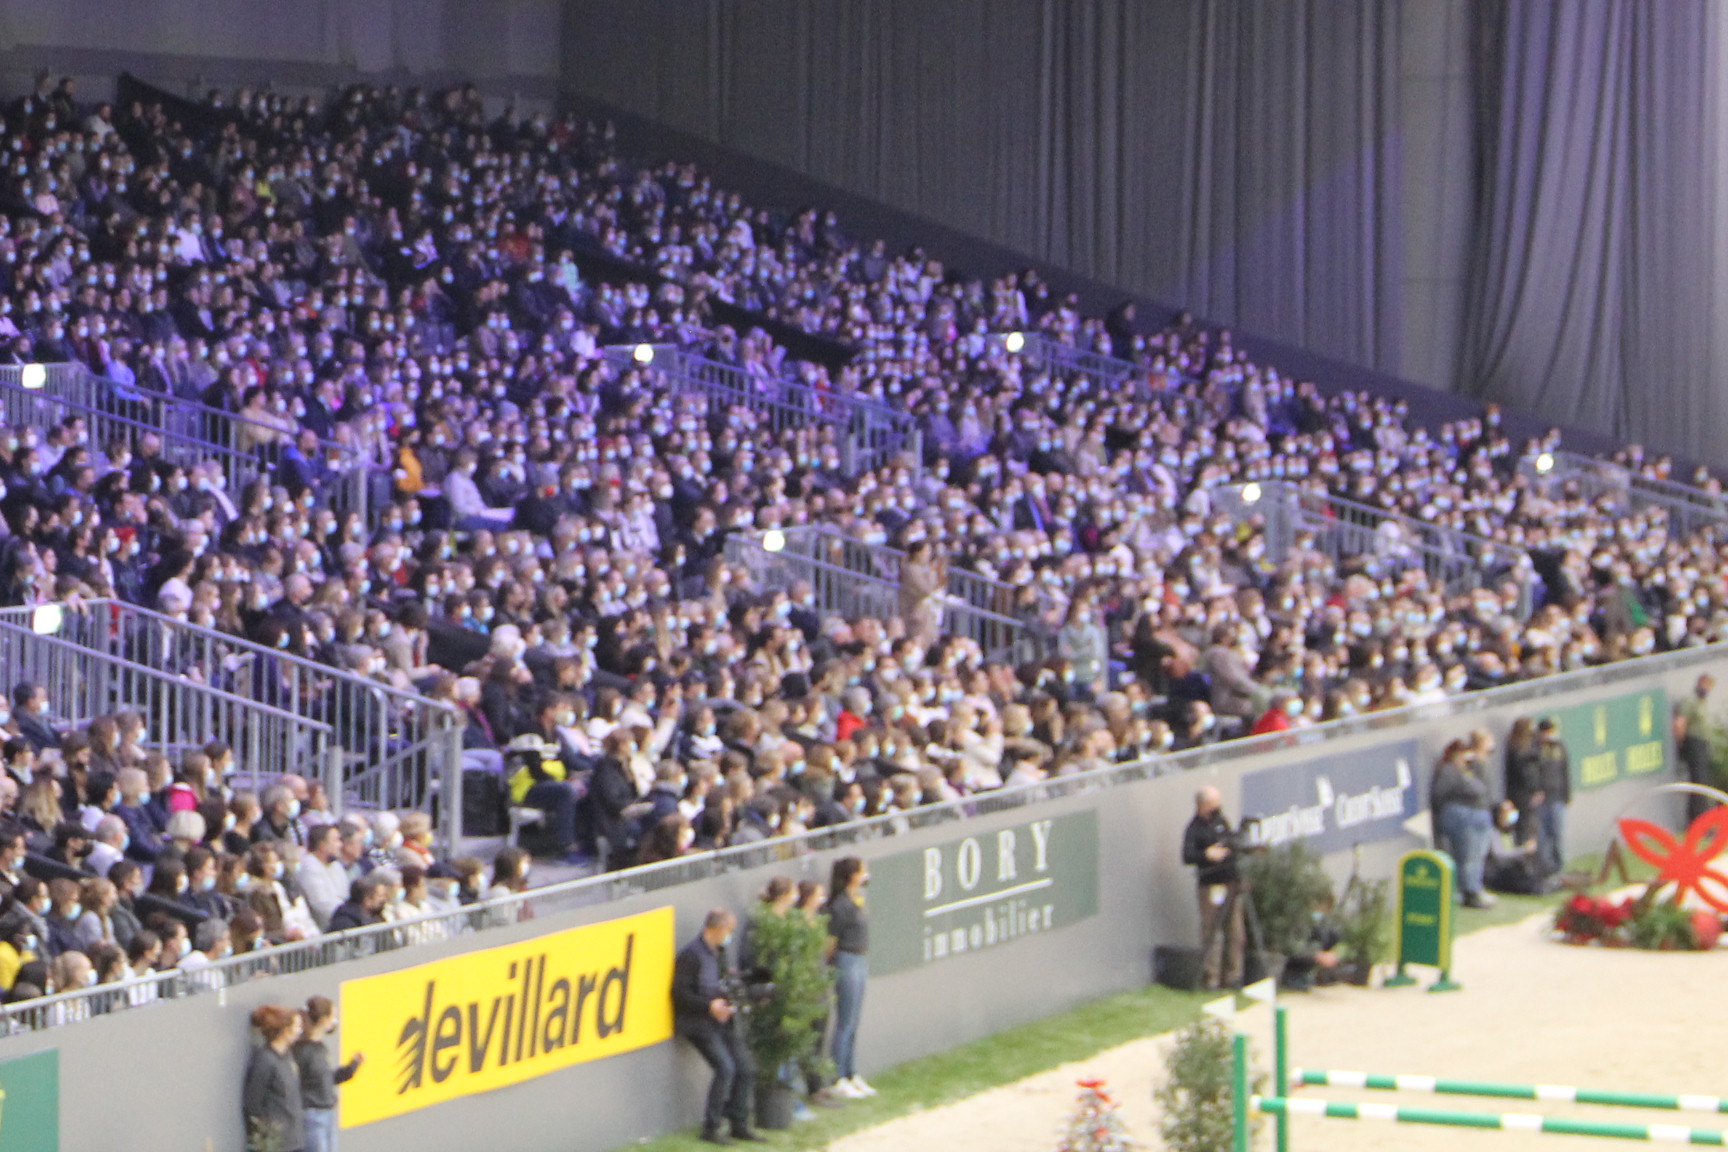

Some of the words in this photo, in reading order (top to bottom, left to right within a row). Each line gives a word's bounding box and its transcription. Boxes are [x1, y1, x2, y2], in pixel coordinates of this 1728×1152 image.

[923, 820, 1052, 900] BORY
[924, 900, 1054, 962] immobilier
[396, 932, 635, 1095] devillard
